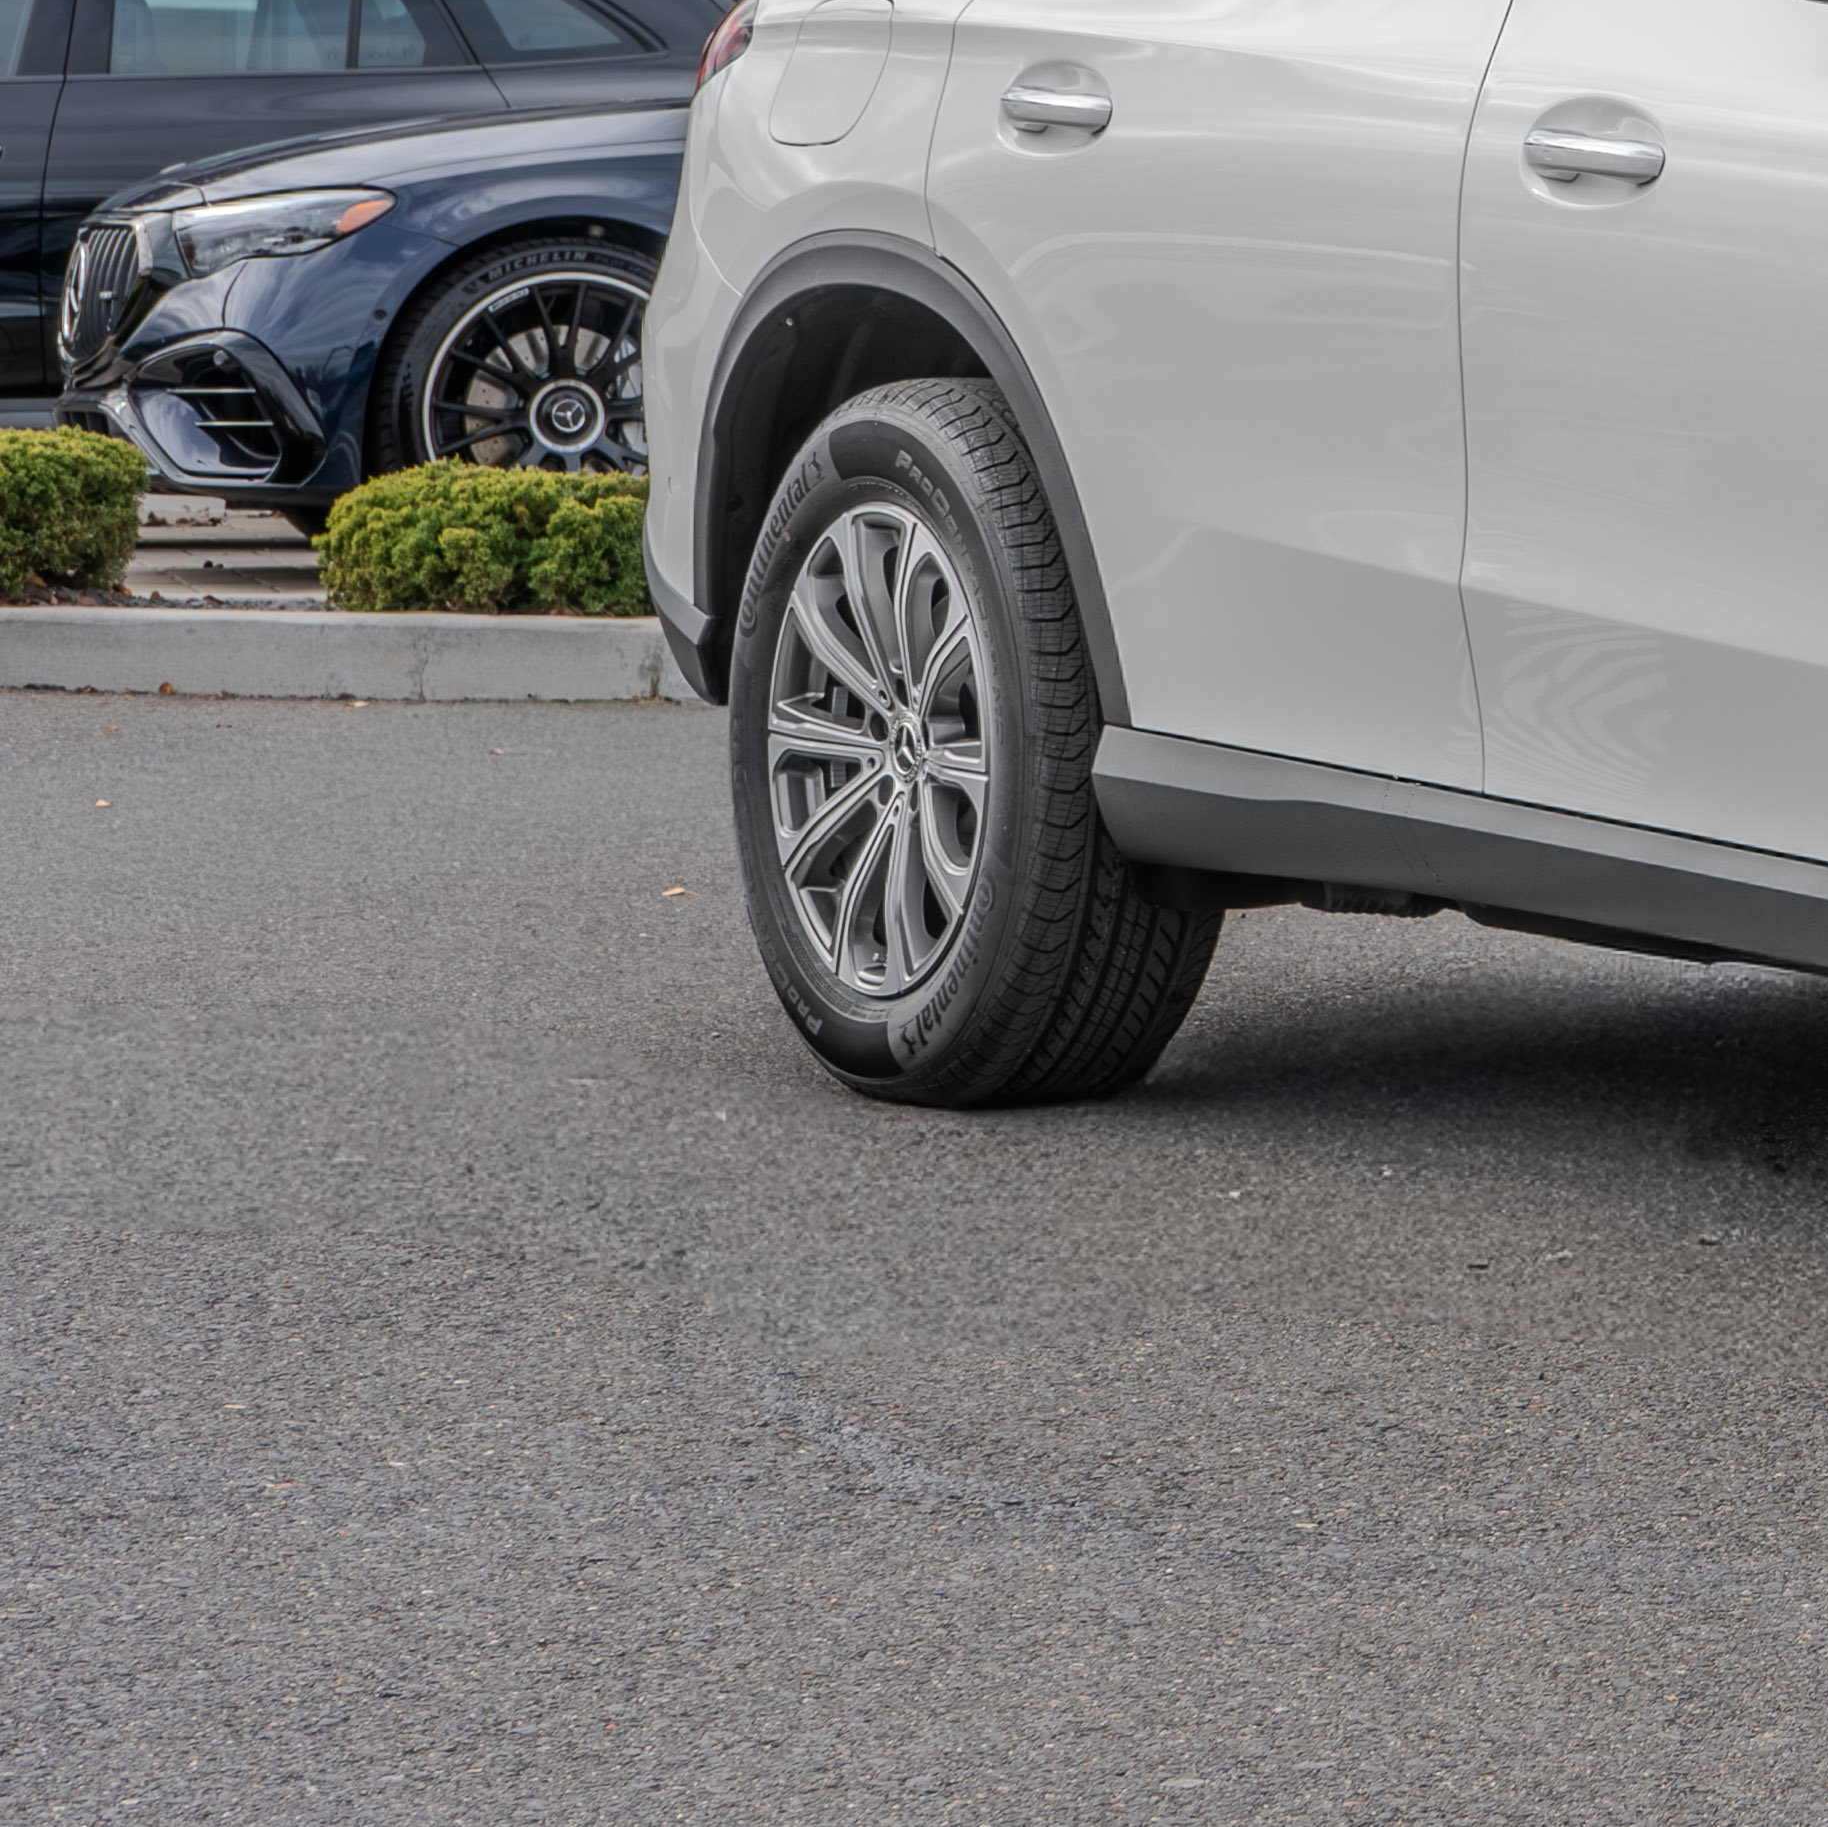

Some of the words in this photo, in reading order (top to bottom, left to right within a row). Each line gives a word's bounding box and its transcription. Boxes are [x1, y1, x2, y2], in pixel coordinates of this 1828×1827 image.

[488, 251, 588, 281] MICHELIN
[739, 461, 812, 638] Continental
[916, 875, 996, 1047] Continental
